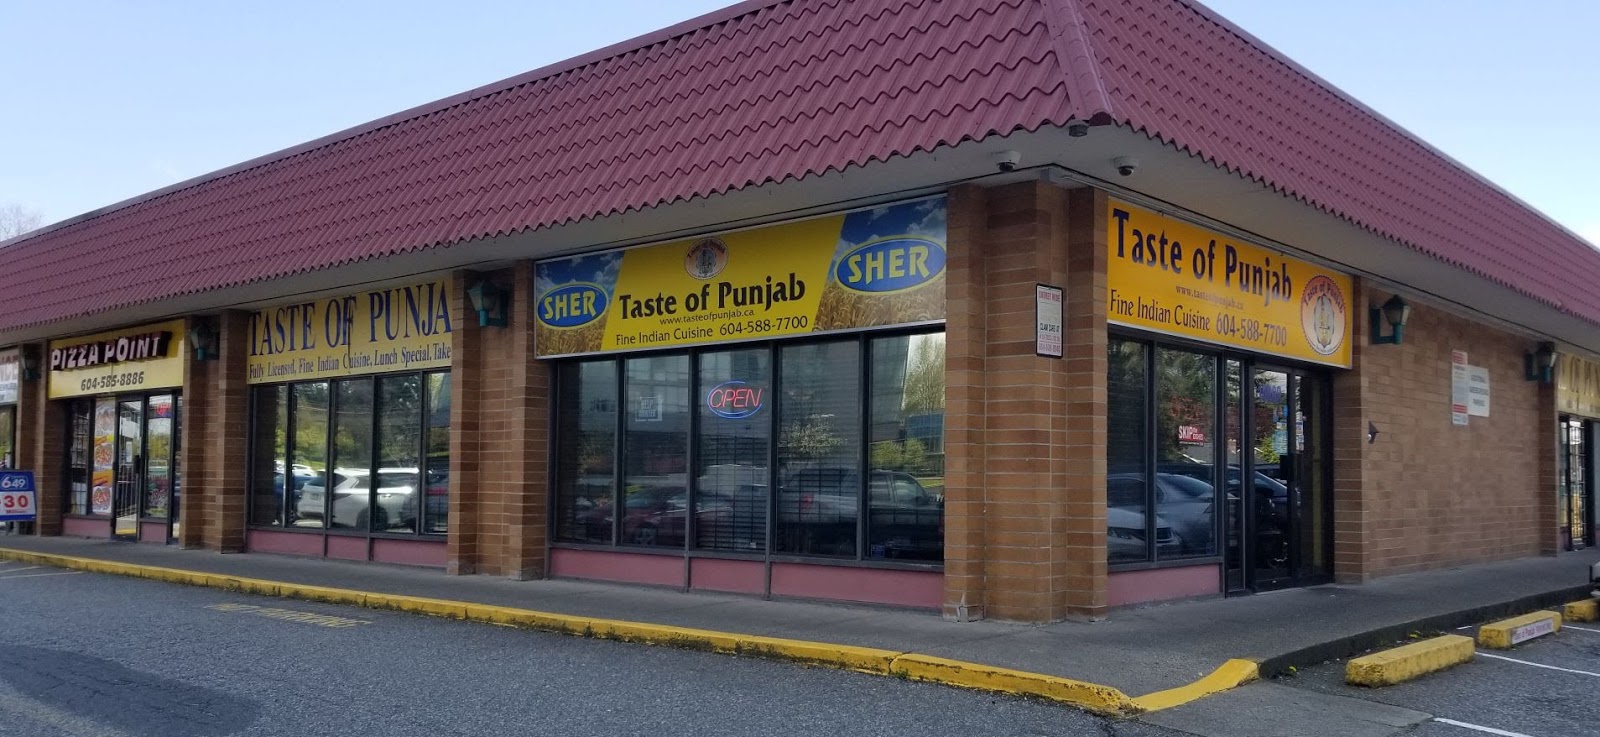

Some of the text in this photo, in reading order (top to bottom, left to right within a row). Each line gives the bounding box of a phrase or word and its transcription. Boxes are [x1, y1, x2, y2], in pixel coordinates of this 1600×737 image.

[848, 245, 930, 285] SHER
[1113, 208, 1292, 307] Taste of Punjab
[543, 290, 597, 321] SHER
[619, 272, 806, 320] Taste of Punjab
[249, 281, 452, 356] TASTE OF PUNJA
[616, 316, 808, 346] Fine Indian Cuisine 604-588-7700
[659, 309, 754, 325] www.tasteofpunjab.ca
[1110, 289, 1287, 347] Fine Indian Cuisine 604-588-7700
[50, 335, 161, 371] PIZZA POINT
[318, 356, 339, 372] Indian
[374, 348, 398, 366] Lunch
[433, 342, 452, 360] Take
[709, 388, 763, 409] OPEN
[1179, 425, 1192, 439] SKIP
